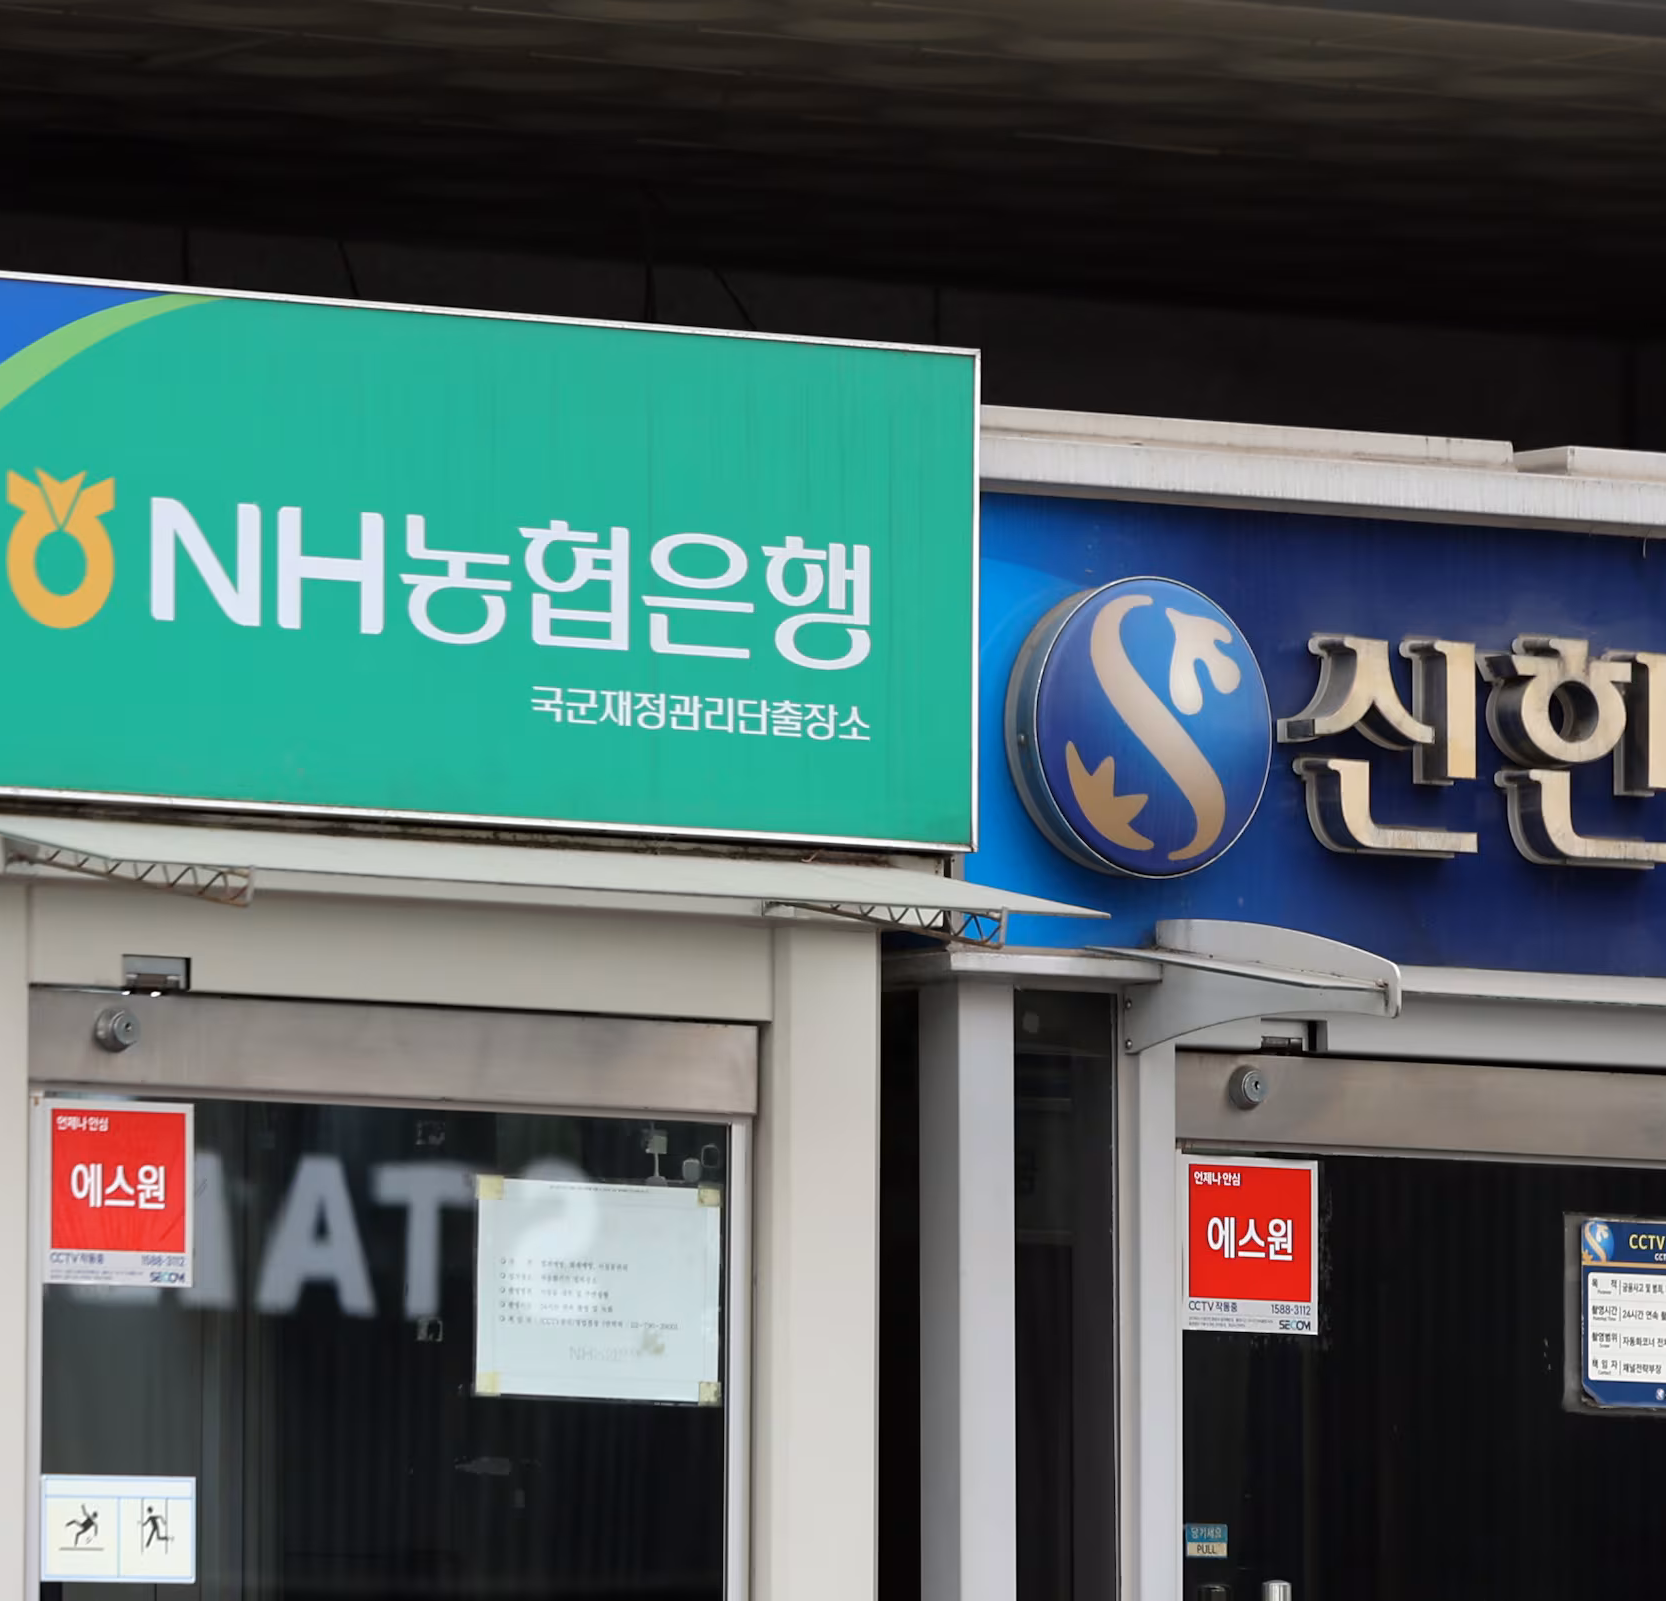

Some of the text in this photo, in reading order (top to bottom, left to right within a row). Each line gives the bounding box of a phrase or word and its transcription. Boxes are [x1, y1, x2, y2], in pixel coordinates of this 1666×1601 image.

[531, 686, 872, 743] 국군재정관리단출장소
[70, 1162, 166, 1210] 에스원
[1207, 1216, 1293, 1261] 에스원
[1629, 1234, 1666, 1250] CCTV
[1188, 1300, 1214, 1312] CCTV
[1271, 1304, 1311, 1316] 1588-3112
[1278, 1319, 1311, 1332] SECOM
[1196, 1543, 1216, 1555] PULL
